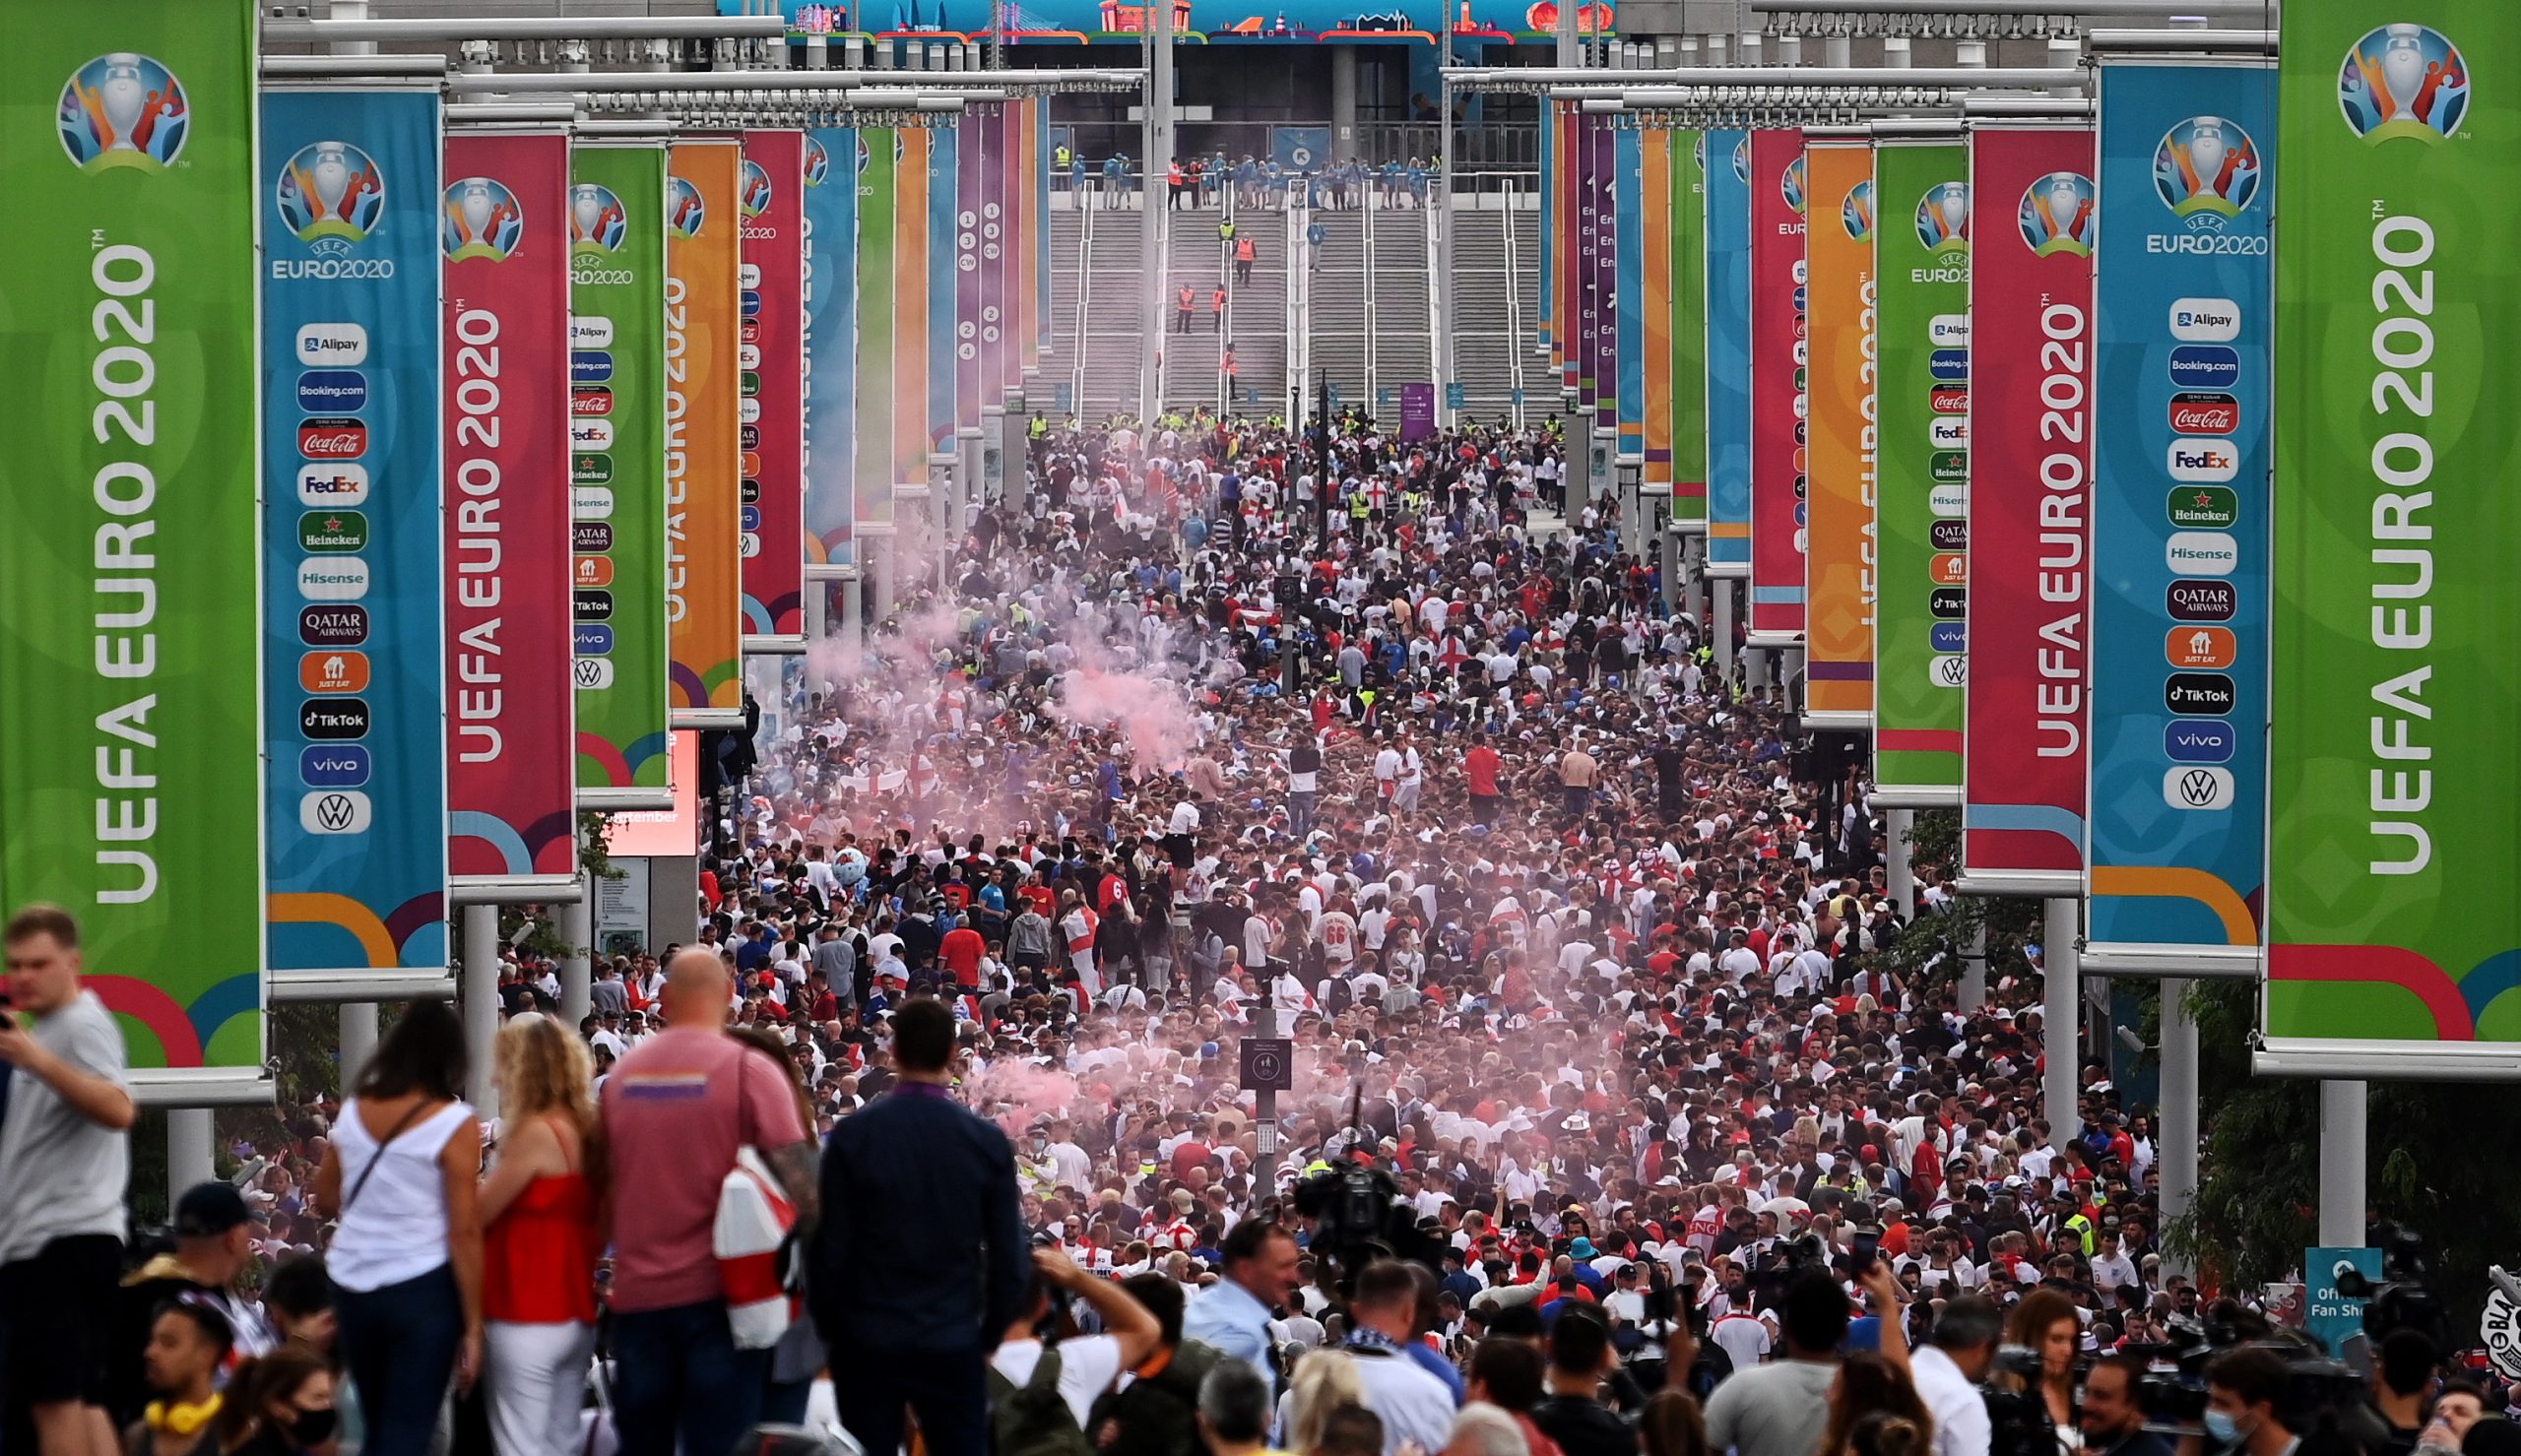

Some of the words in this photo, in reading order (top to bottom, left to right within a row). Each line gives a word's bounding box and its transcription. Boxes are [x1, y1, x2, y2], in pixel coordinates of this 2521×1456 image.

[965, 216, 971, 224] 1
[2185, 216, 2225, 231] UEFA
[311, 242, 352, 256] UEFA
[960, 258, 974, 266] CW
[2193, 312, 2232, 328] Alipay
[2371, 215, 2435, 417] 2020
[579, 328, 607, 337] Alipay
[93, 244, 156, 446] 2020
[320, 338, 359, 352] Alipay
[964, 347, 971, 355] 4
[2172, 360, 2236, 372] Booking.com
[456, 309, 500, 448] 2020
[2040, 303, 2085, 444] 2020
[299, 385, 364, 398] Booking.com
[2174, 451, 2230, 470] FedEx
[305, 476, 359, 494] FedEx
[2174, 509, 2230, 522] Heineken
[457, 458, 501, 607] EURO
[2038, 453, 2084, 602] EURO
[306, 534, 360, 546] Heineken
[2371, 432, 2434, 650] EURO
[2170, 547, 2232, 561] Hisense
[94, 462, 157, 677] EURO
[302, 572, 364, 585] Hisense
[2173, 588, 2229, 605] QATAR
[577, 601, 609, 611] TikTok
[2186, 602, 2229, 613] AIRWAYS
[305, 612, 361, 630] QATAR
[319, 626, 362, 637] AIRWAYS
[459, 617, 502, 763] UEFA
[2036, 612, 2082, 758] UEFA
[2185, 689, 2230, 702] TikTok
[319, 714, 364, 727] TikTok
[2177, 733, 2222, 747] vivo
[313, 758, 357, 772] vivo
[2369, 665, 2433, 875] UEFA
[96, 694, 159, 904] UEFA
[1113, 881, 1122, 899] 6
[1326, 925, 1345, 945] 66
[2311, 1304, 2338, 1317] Fan
